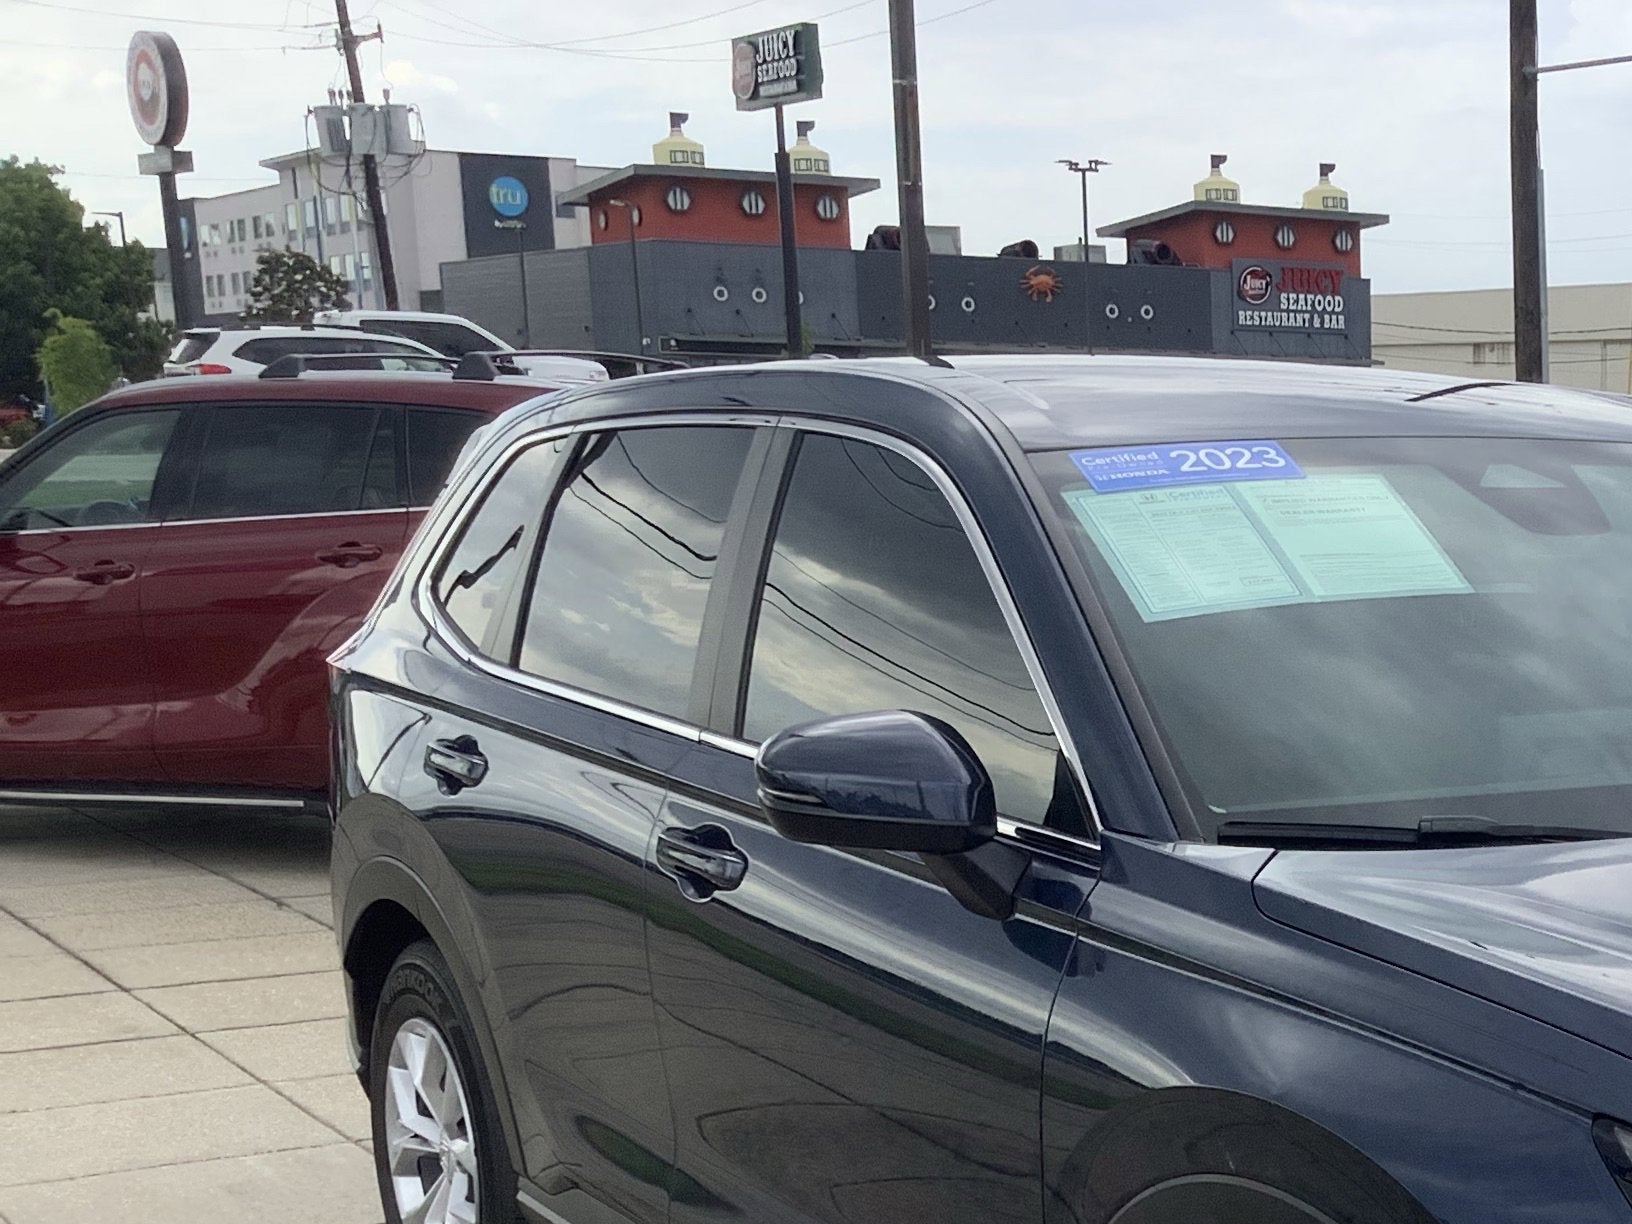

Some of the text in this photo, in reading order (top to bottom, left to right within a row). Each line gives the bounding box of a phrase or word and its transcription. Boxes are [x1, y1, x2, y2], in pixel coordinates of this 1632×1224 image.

[756, 29, 795, 64] JUICY
[757, 57, 798, 83] SEAFOOD
[1276, 267, 1344, 294] JUICY
[1280, 292, 1344, 312] SEAFOOD
[1238, 310, 1345, 330] RESTAURANT & BAR
[1081, 446, 1286, 473] Certified 2023
